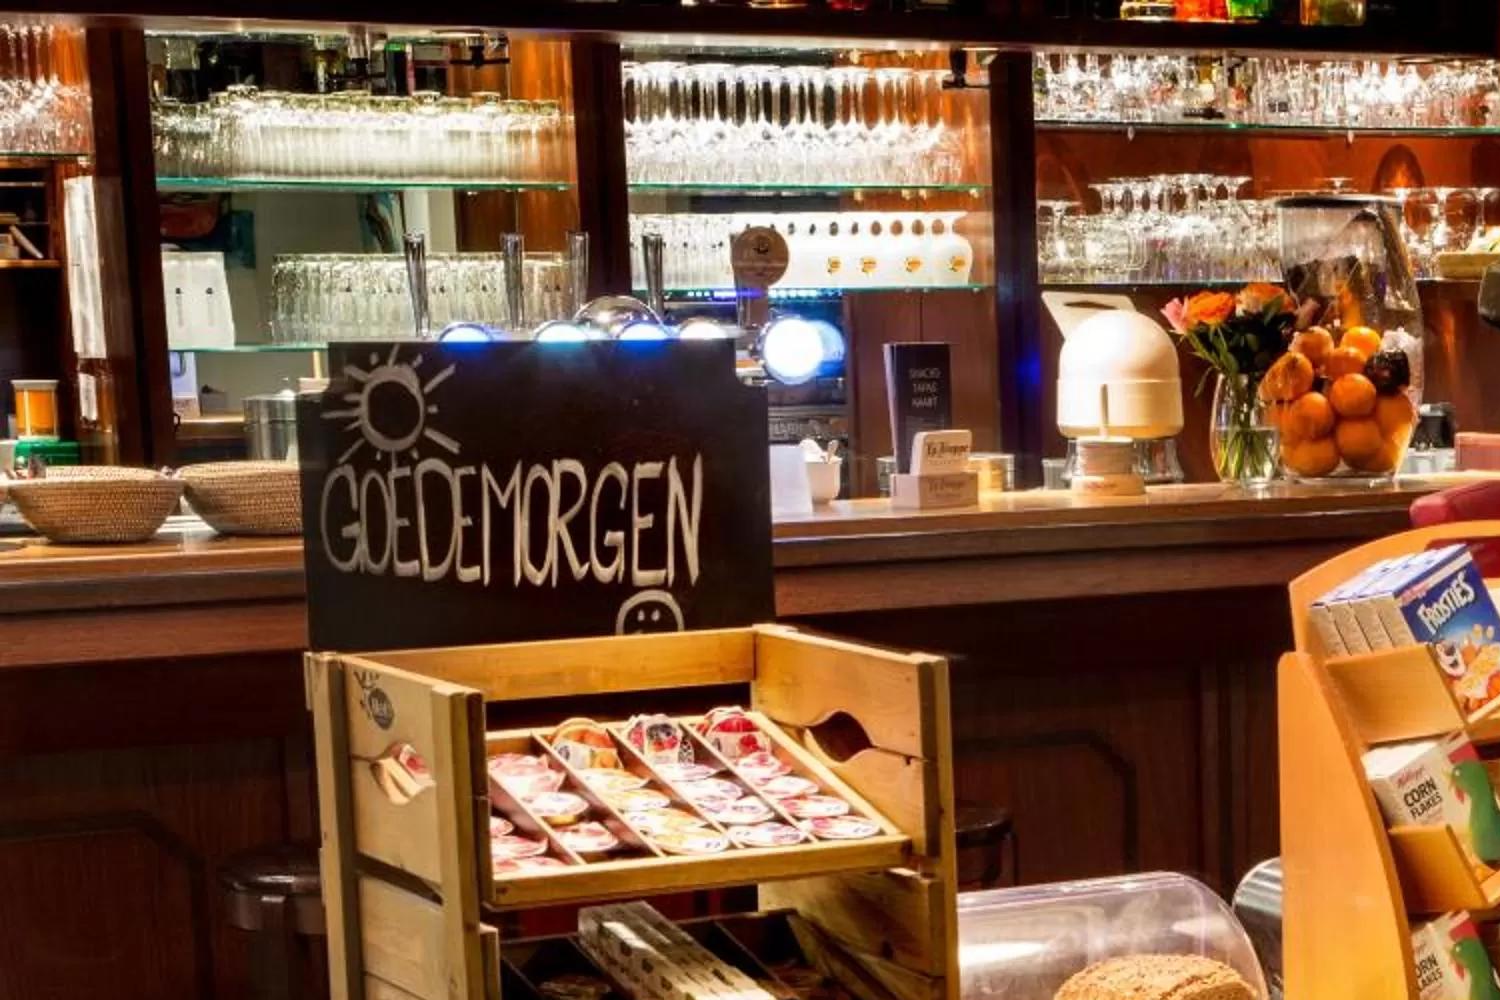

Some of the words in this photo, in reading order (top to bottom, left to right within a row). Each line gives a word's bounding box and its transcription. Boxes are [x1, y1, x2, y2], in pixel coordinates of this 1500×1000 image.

[320, 453, 702, 588] GOEDEMORGEN
[1416, 570, 1476, 635] FROSTIES
[1403, 776, 1438, 808] CORN
[1409, 791, 1443, 821] FLAKES
